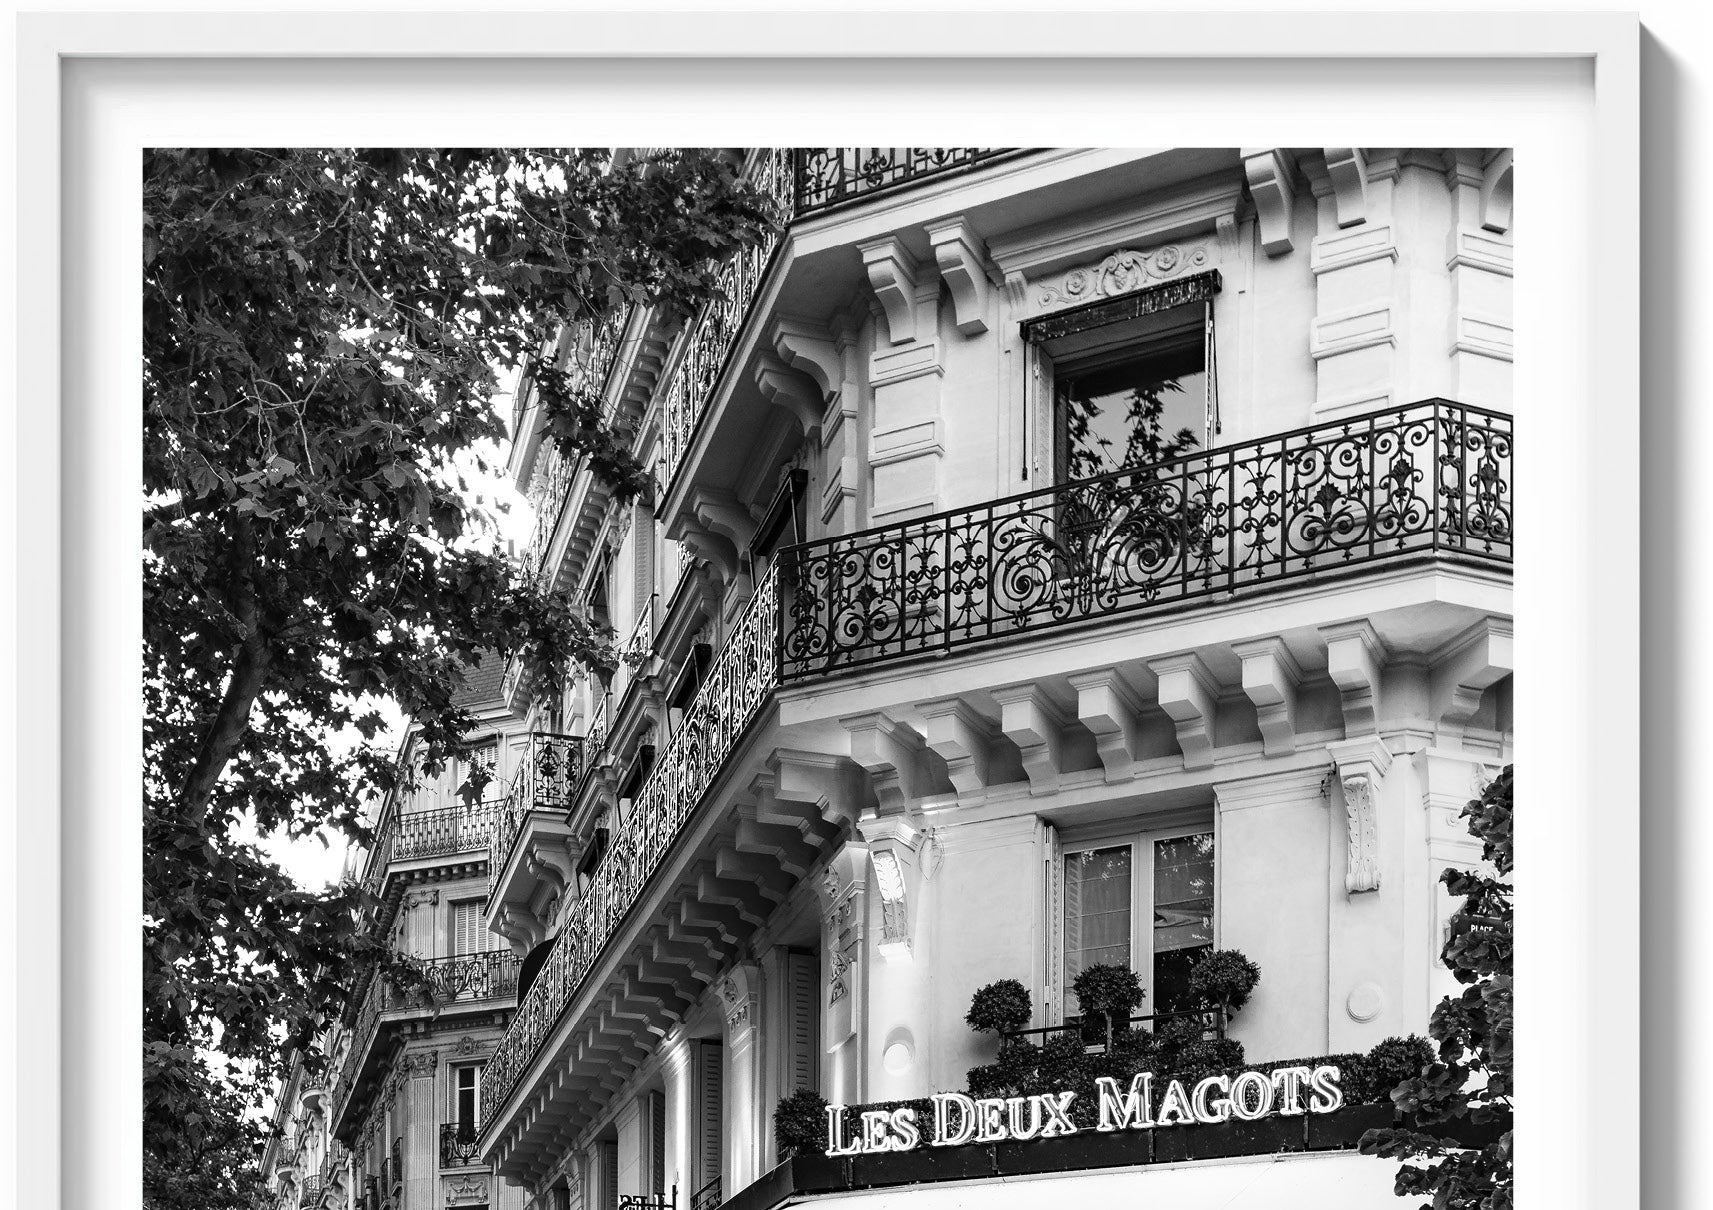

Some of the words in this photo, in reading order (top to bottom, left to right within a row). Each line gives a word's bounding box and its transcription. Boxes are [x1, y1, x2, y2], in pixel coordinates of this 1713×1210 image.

[825, 1104, 919, 1156] LES
[931, 1092, 1078, 1146] DEUX
[1095, 1065, 1344, 1132] MAGOTS
